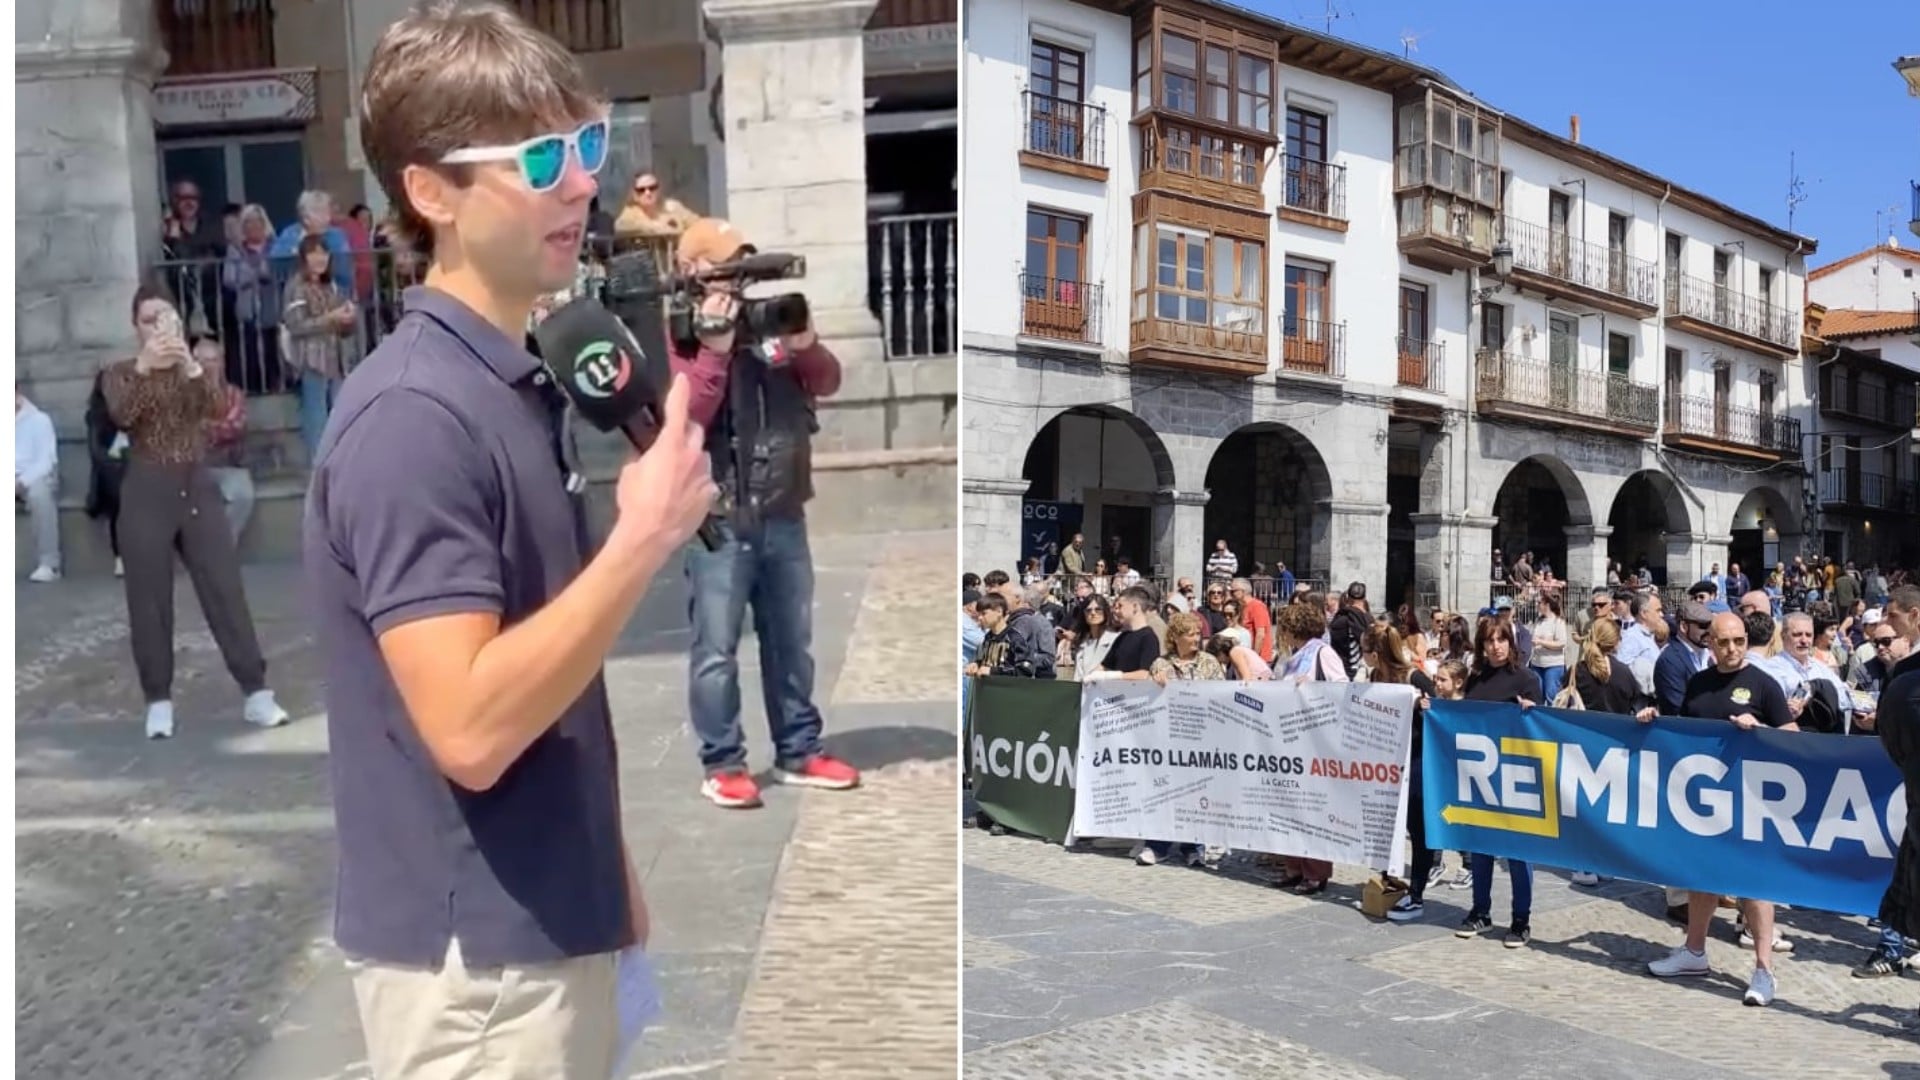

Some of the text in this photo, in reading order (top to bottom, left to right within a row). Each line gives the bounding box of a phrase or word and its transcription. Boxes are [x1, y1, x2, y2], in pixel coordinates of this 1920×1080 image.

[1351, 694, 1400, 718] EL DEBATE
[1092, 748, 1112, 767] ¿A
[1119, 748, 1163, 766] ESTO
[1168, 748, 1238, 770] LLAMÁIS
[1243, 754, 1304, 775] CASOS
[1261, 777, 1300, 788] LA GACETA
